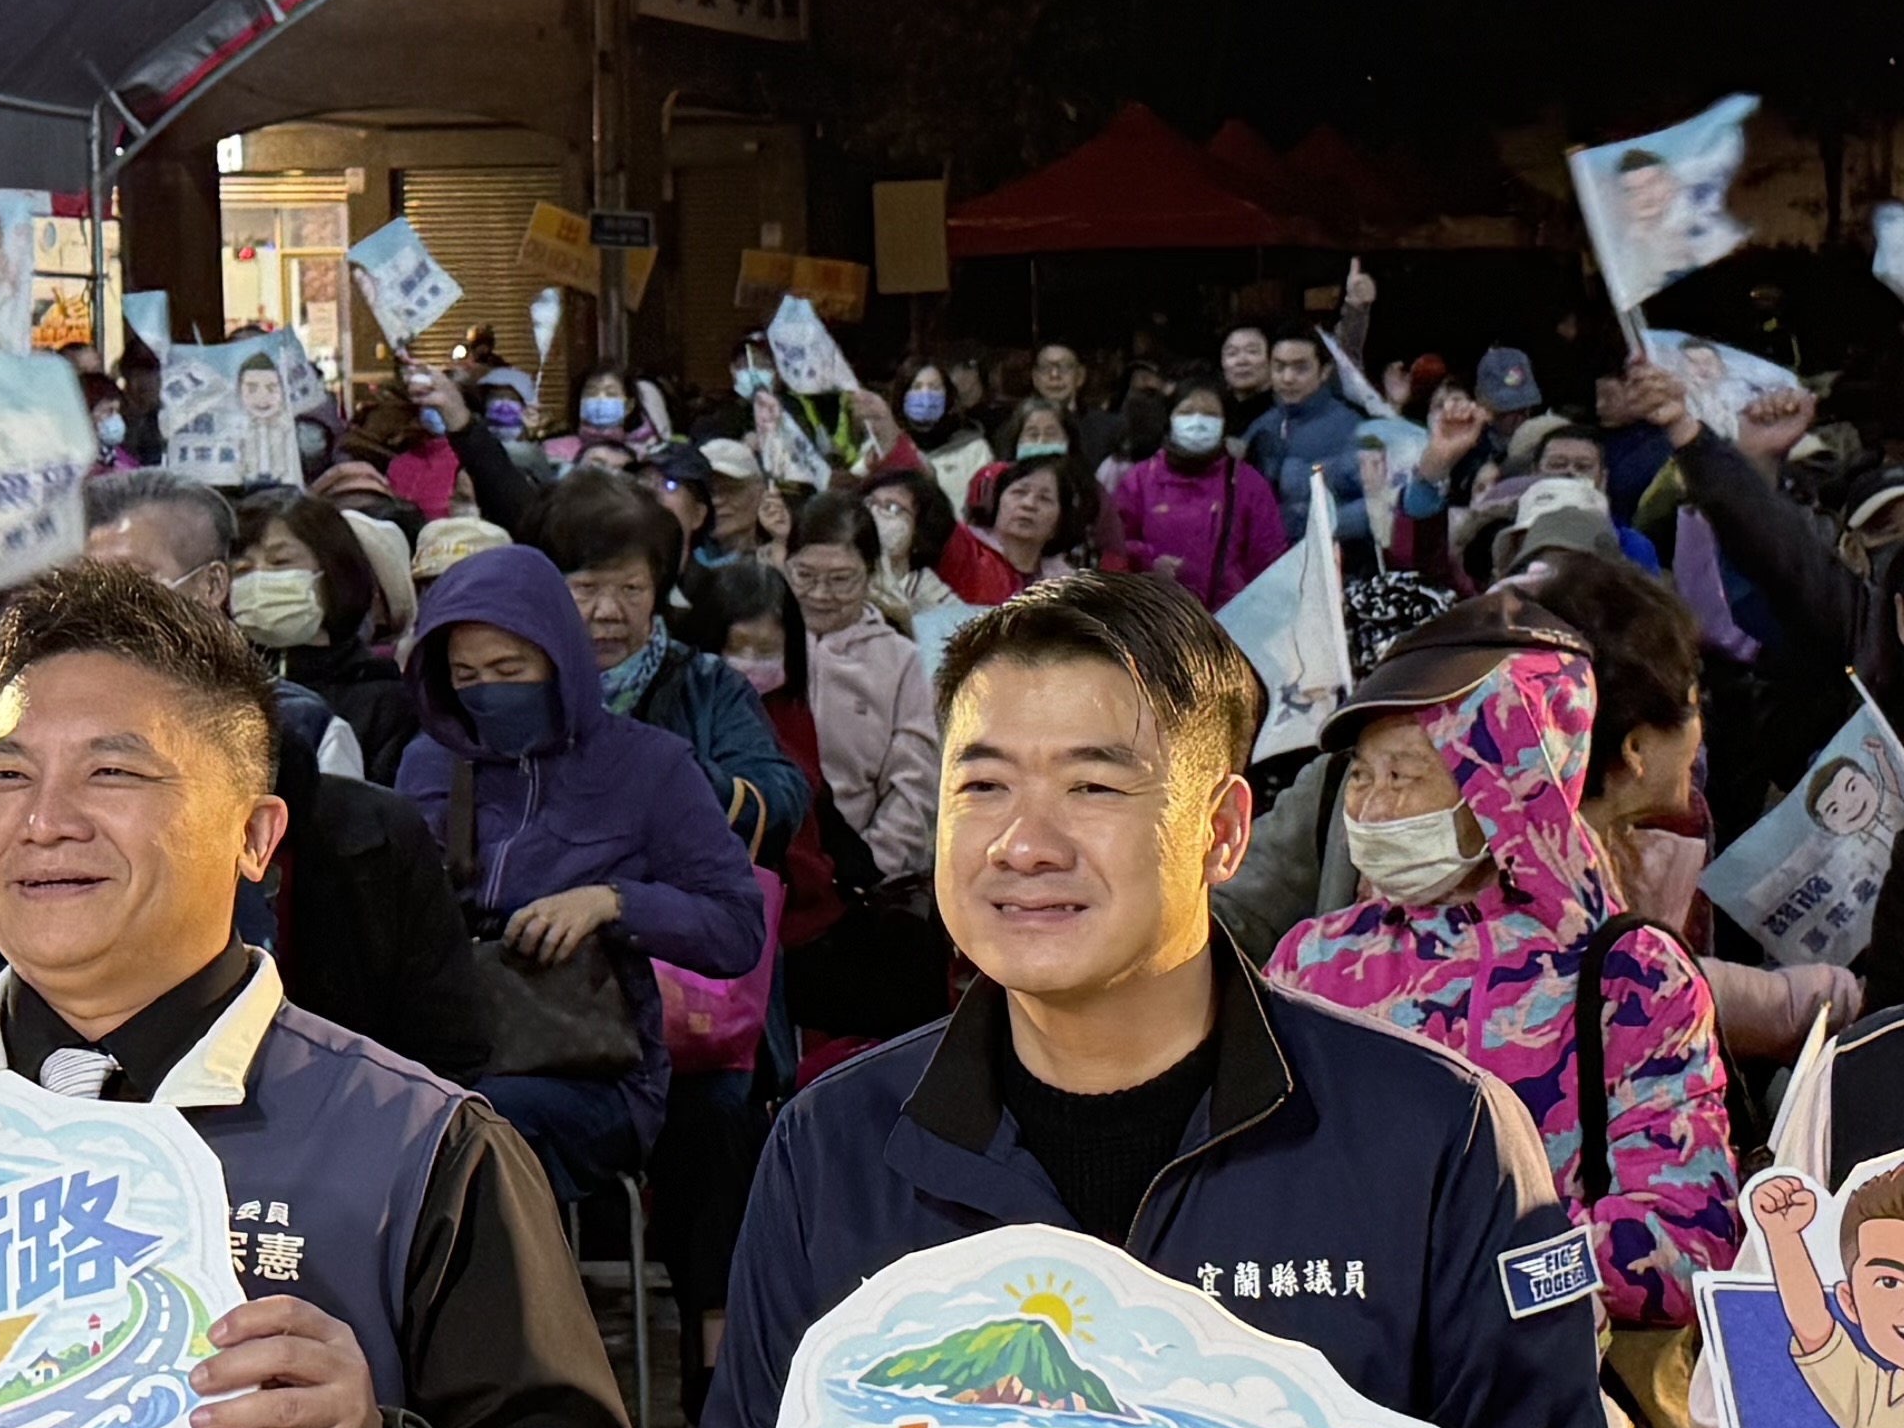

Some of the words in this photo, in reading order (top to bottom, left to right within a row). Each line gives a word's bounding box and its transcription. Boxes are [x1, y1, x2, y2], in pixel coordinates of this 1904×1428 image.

[1195, 1257, 1368, 1300] 宜蘭縣議員
